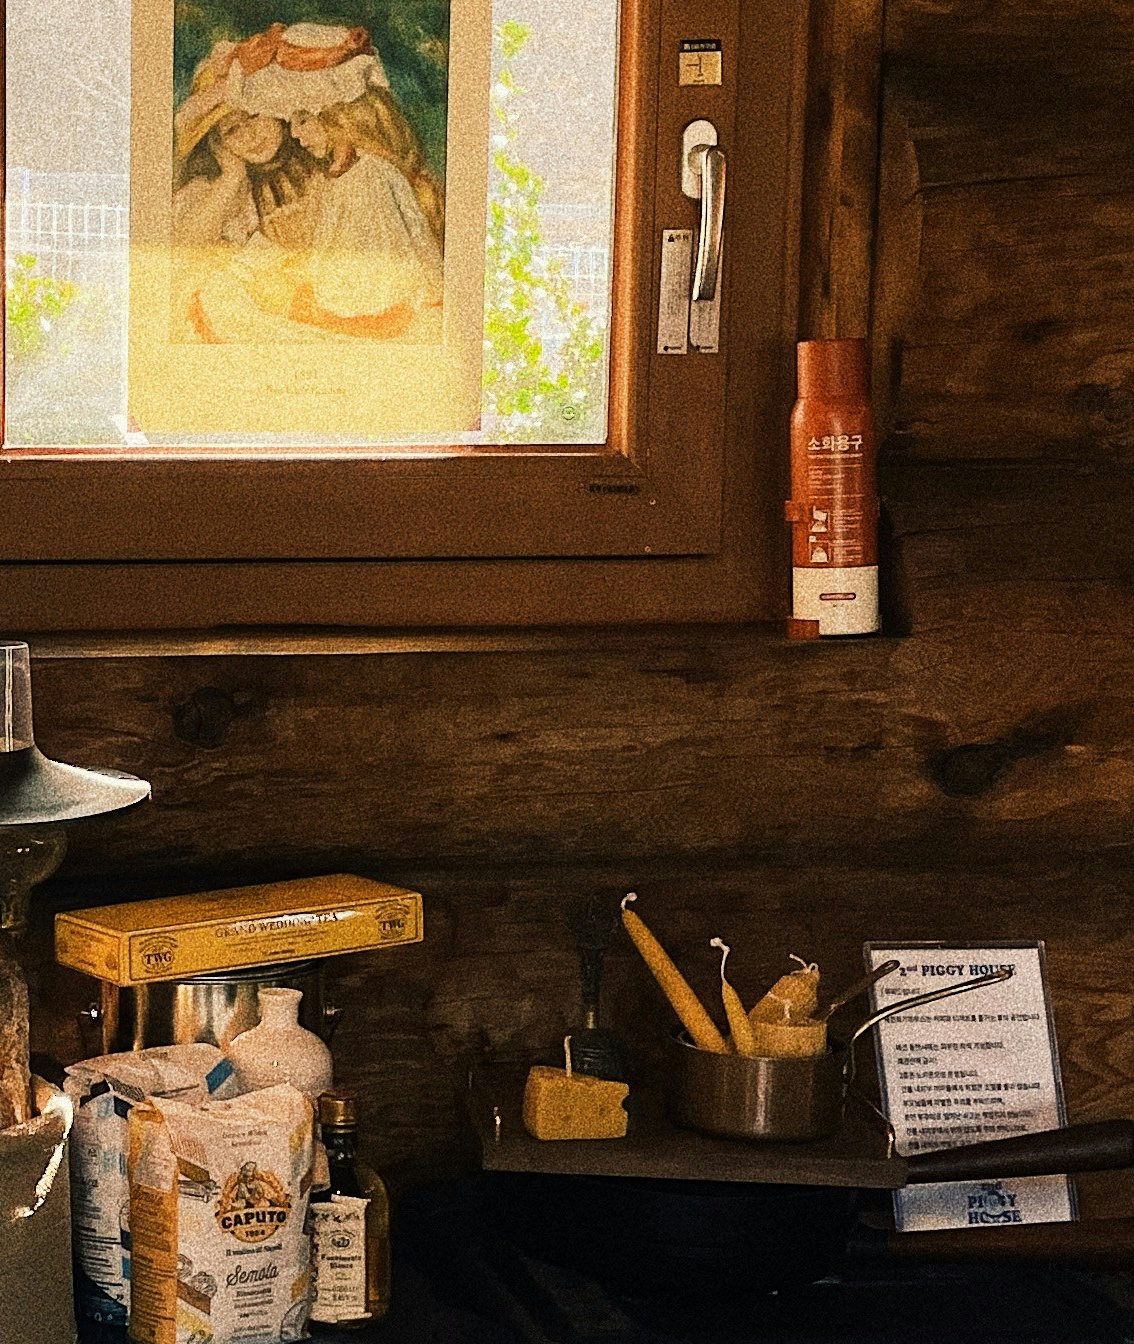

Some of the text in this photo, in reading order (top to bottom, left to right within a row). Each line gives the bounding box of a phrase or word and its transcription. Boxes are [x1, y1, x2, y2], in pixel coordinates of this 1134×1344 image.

[807, 435, 864, 452] 소화용구
[214, 922, 257, 939] GRAND
[316, 912, 339, 925] TEA
[379, 918, 406, 931] TWG
[145, 950, 172, 964] TWG
[921, 964, 965, 976] PIGGY
[969, 963, 1017, 976] HOUSE
[221, 1210, 287, 1230] CAPUTO
[225, 1262, 280, 1289] Semola
